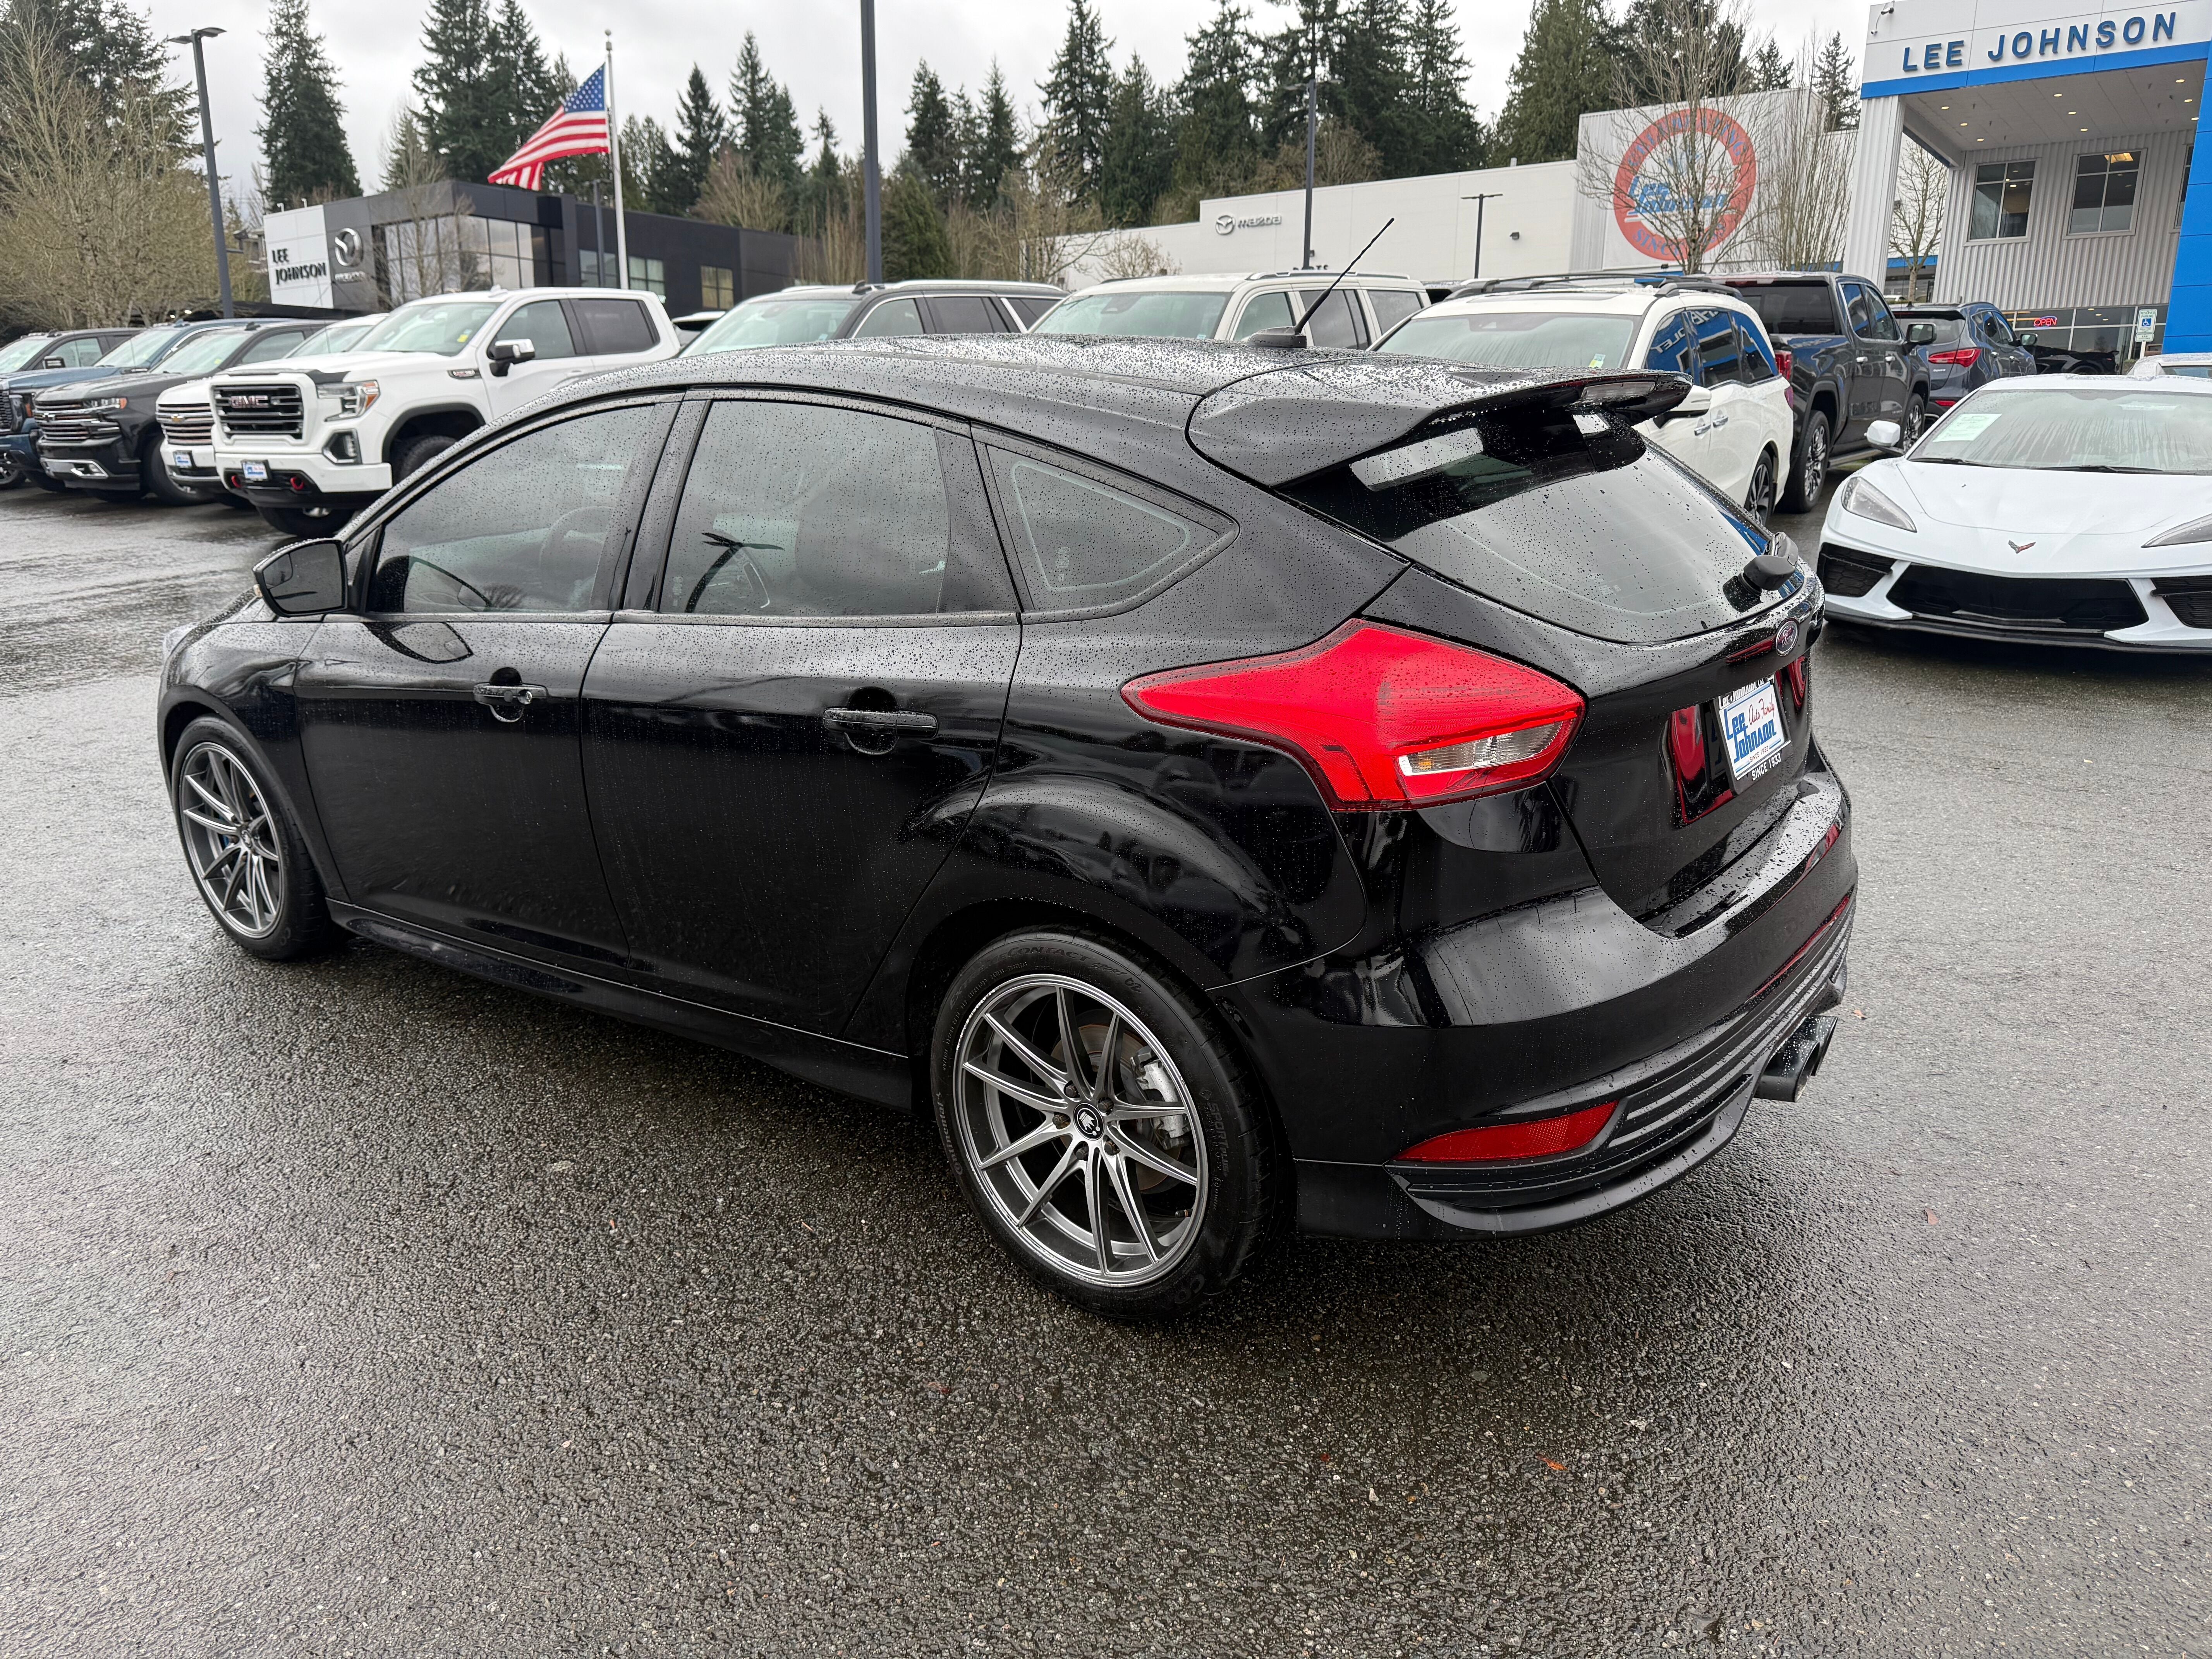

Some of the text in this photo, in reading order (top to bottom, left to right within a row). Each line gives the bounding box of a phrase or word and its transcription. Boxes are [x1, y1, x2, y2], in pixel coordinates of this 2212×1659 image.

[1902, 12, 2176, 71] LEE JOHNSON
[1238, 216, 1281, 228] mazda
[272, 248, 289, 263] LEE
[275, 262, 326, 285] JOHNSON
[2033, 318, 2056, 326] OPEN
[231, 395, 269, 408] GMC
[1749, 693, 1775, 725] Auto Family
[1724, 708, 1748, 741] Lee
[1734, 719, 1777, 763] Johnson
[1750, 745, 1769, 763] SINCE 1933
[1751, 752, 1781, 781] SINCE 1933
